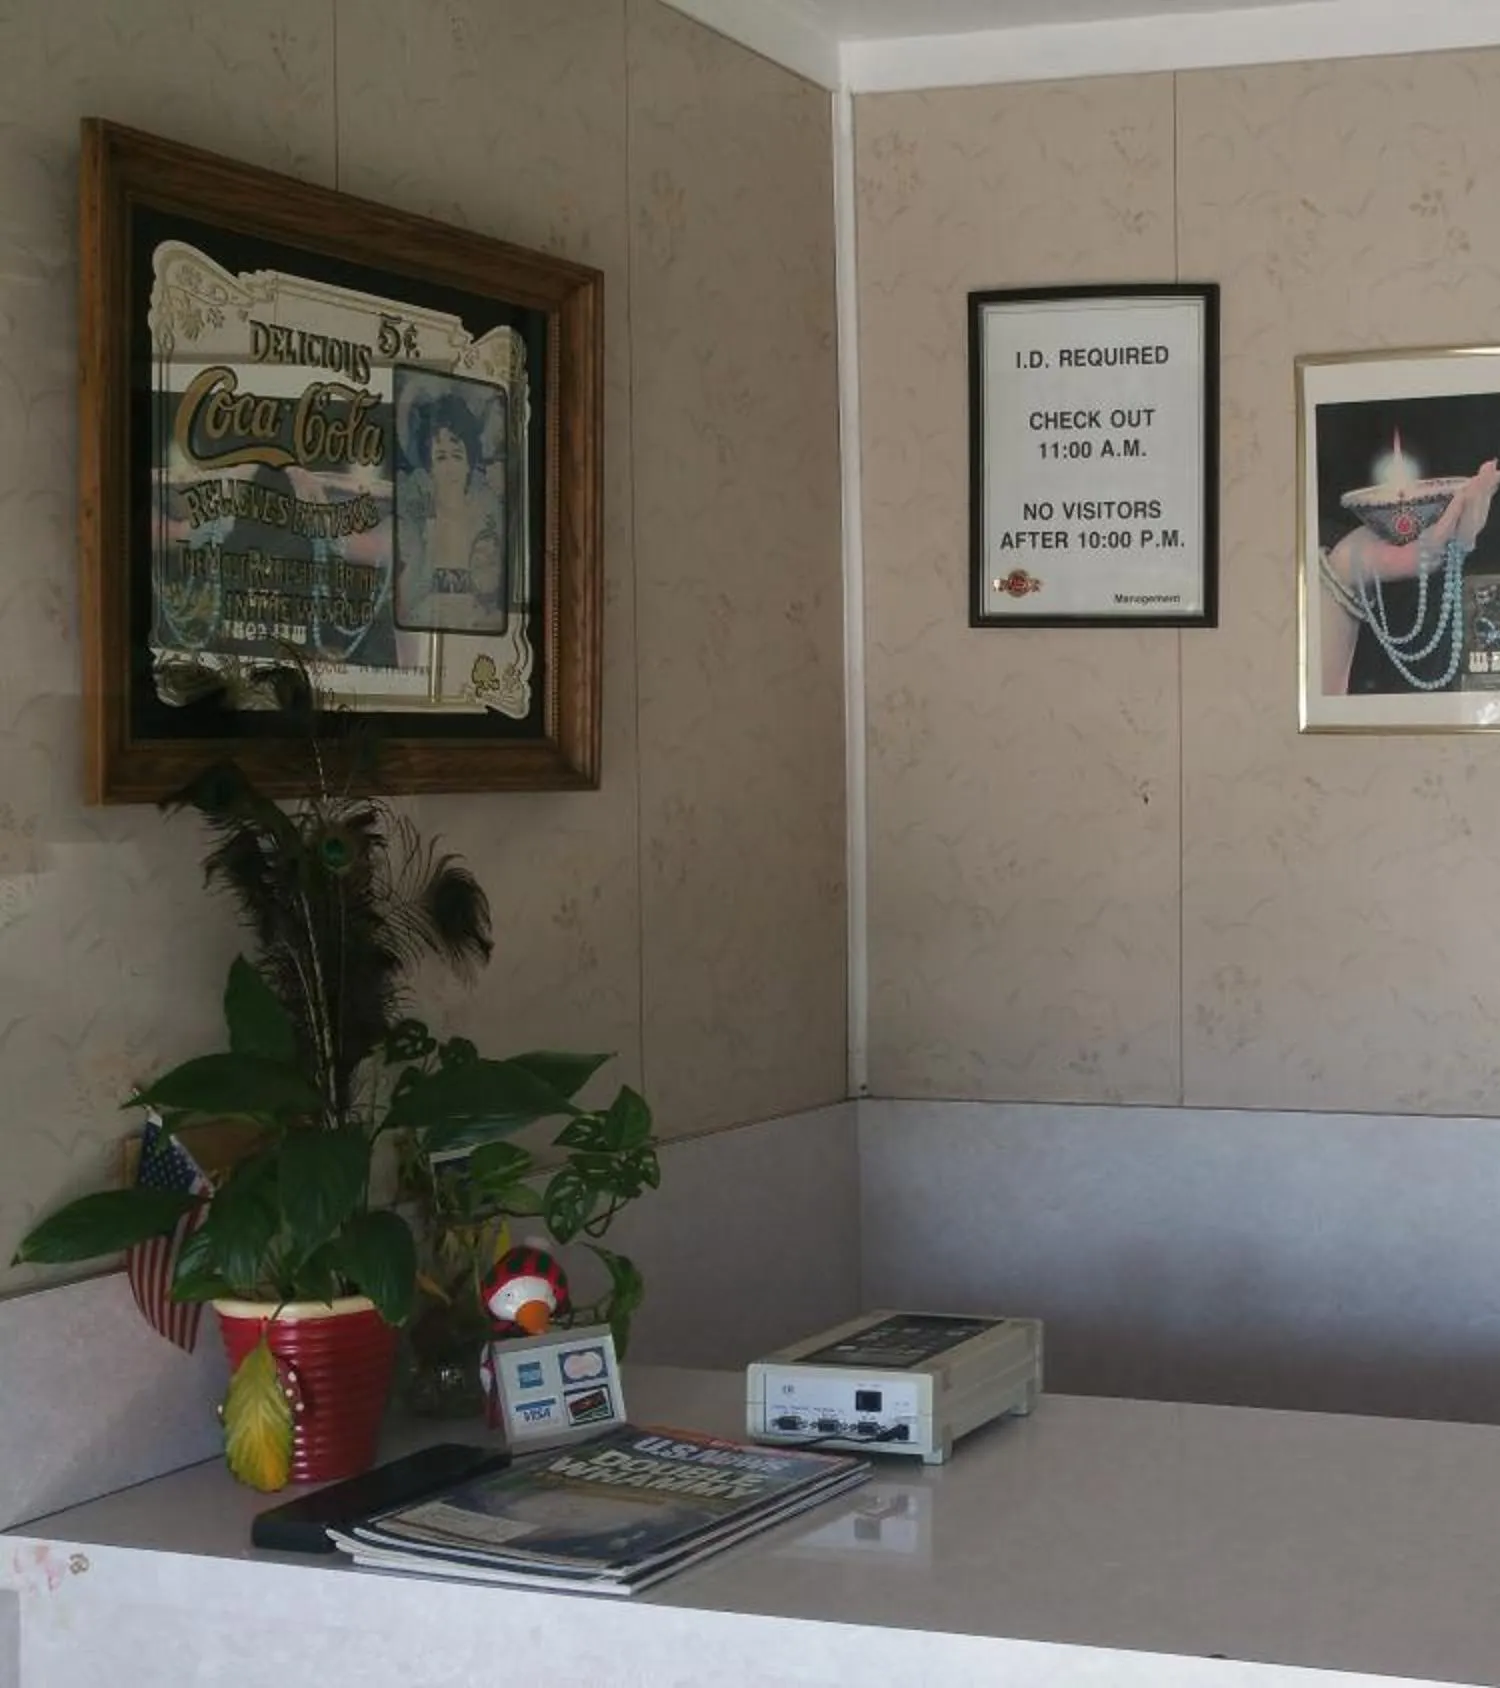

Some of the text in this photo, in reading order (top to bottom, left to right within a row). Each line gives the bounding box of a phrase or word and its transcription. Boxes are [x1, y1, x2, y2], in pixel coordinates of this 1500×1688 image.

[250, 319, 373, 385] DELICIOUS
[1016, 345, 1169, 369] I.D. REQUIRED
[1029, 408, 1156, 431] CHECK OUT
[1038, 438, 1147, 460] 11:00 A.M.
[1023, 499, 1162, 521] NO VISITORS
[1000, 527, 1186, 550] AFTER 10:00 P.M.
[549, 1455, 762, 1500] WHAMMY
[588, 1449, 770, 1489] DOUBLE
